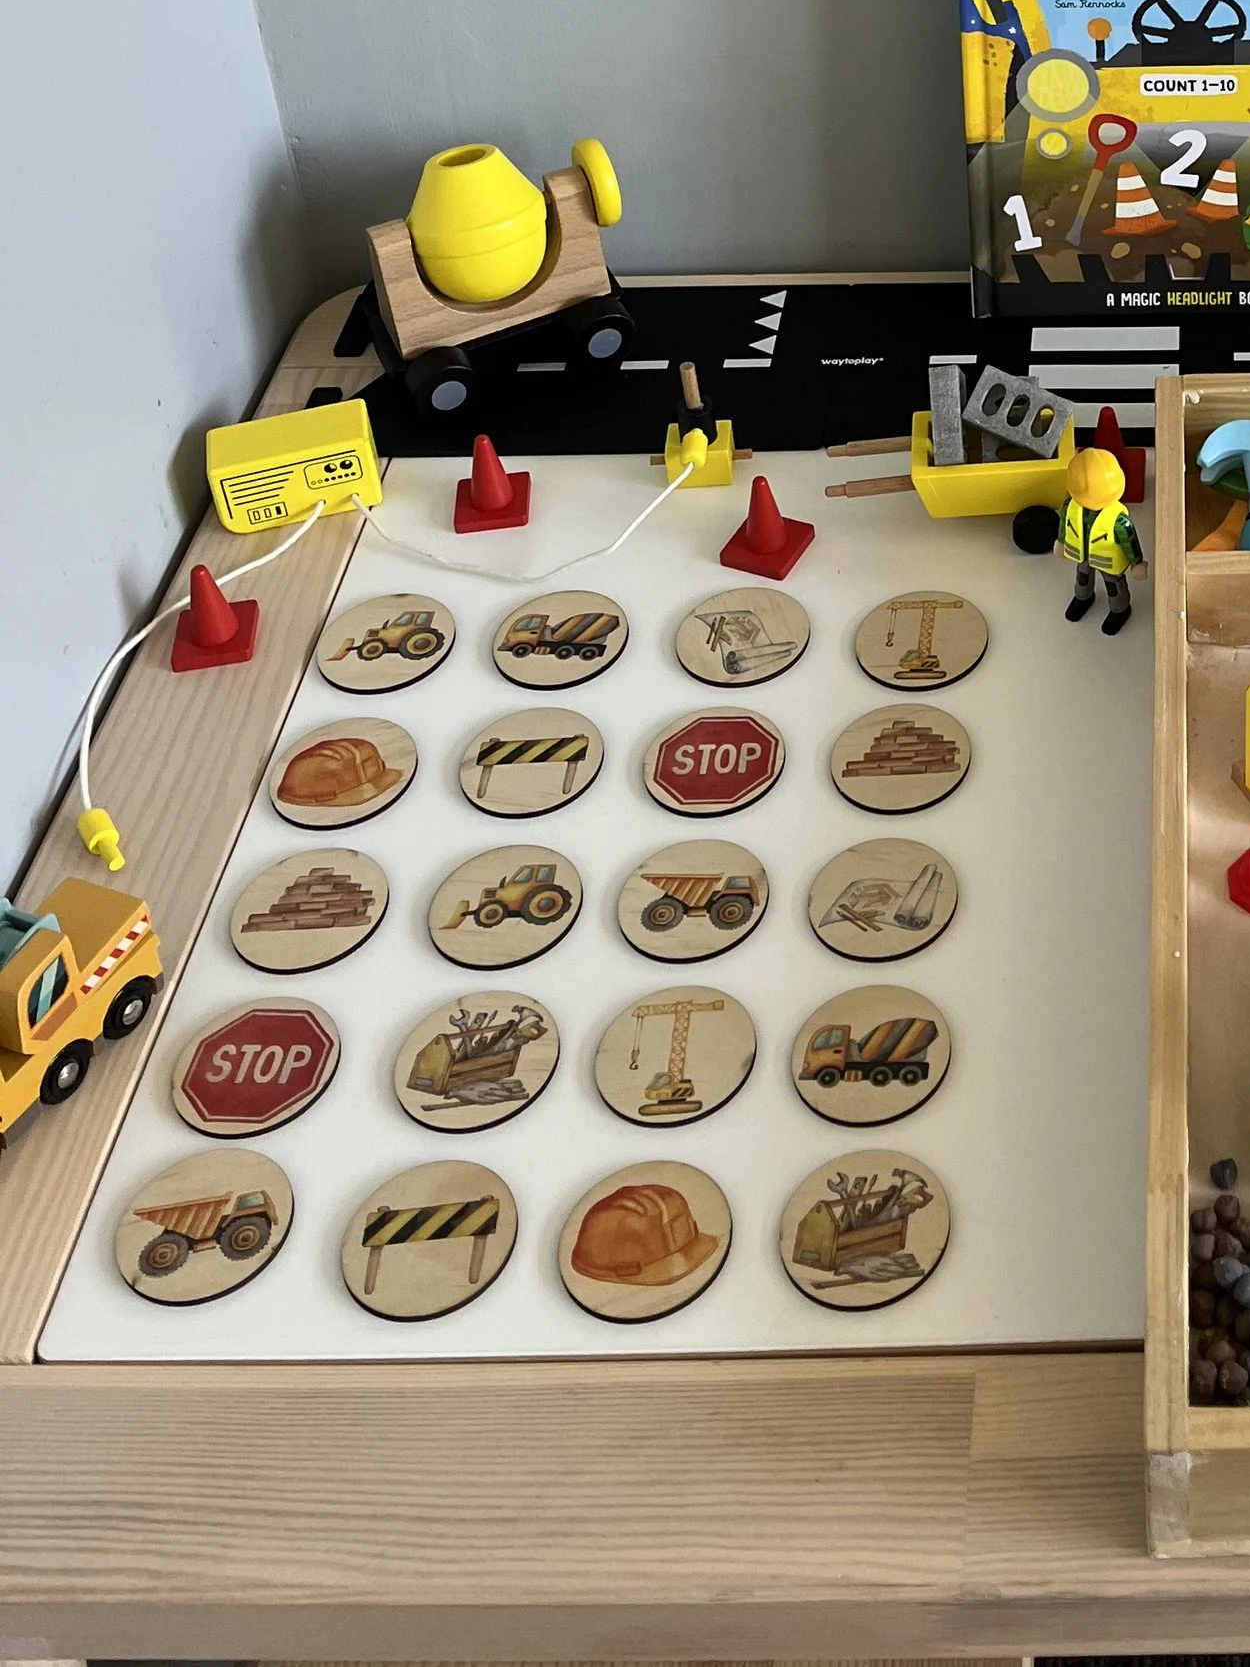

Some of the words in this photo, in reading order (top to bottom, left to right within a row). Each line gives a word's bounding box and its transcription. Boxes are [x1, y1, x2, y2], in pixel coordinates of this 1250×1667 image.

[1143, 79, 1197, 92] COUNT
[1201, 79, 1236, 92] 1-10
[1159, 128, 1208, 189] 2
[1003, 193, 1043, 253] 1
[1106, 292, 1115, 307] A
[1120, 291, 1161, 307] MAGIC
[1167, 291, 1233, 306] HEADLIGHT
[670, 741, 763, 777] STOP
[203, 1043, 313, 1086] STOP
